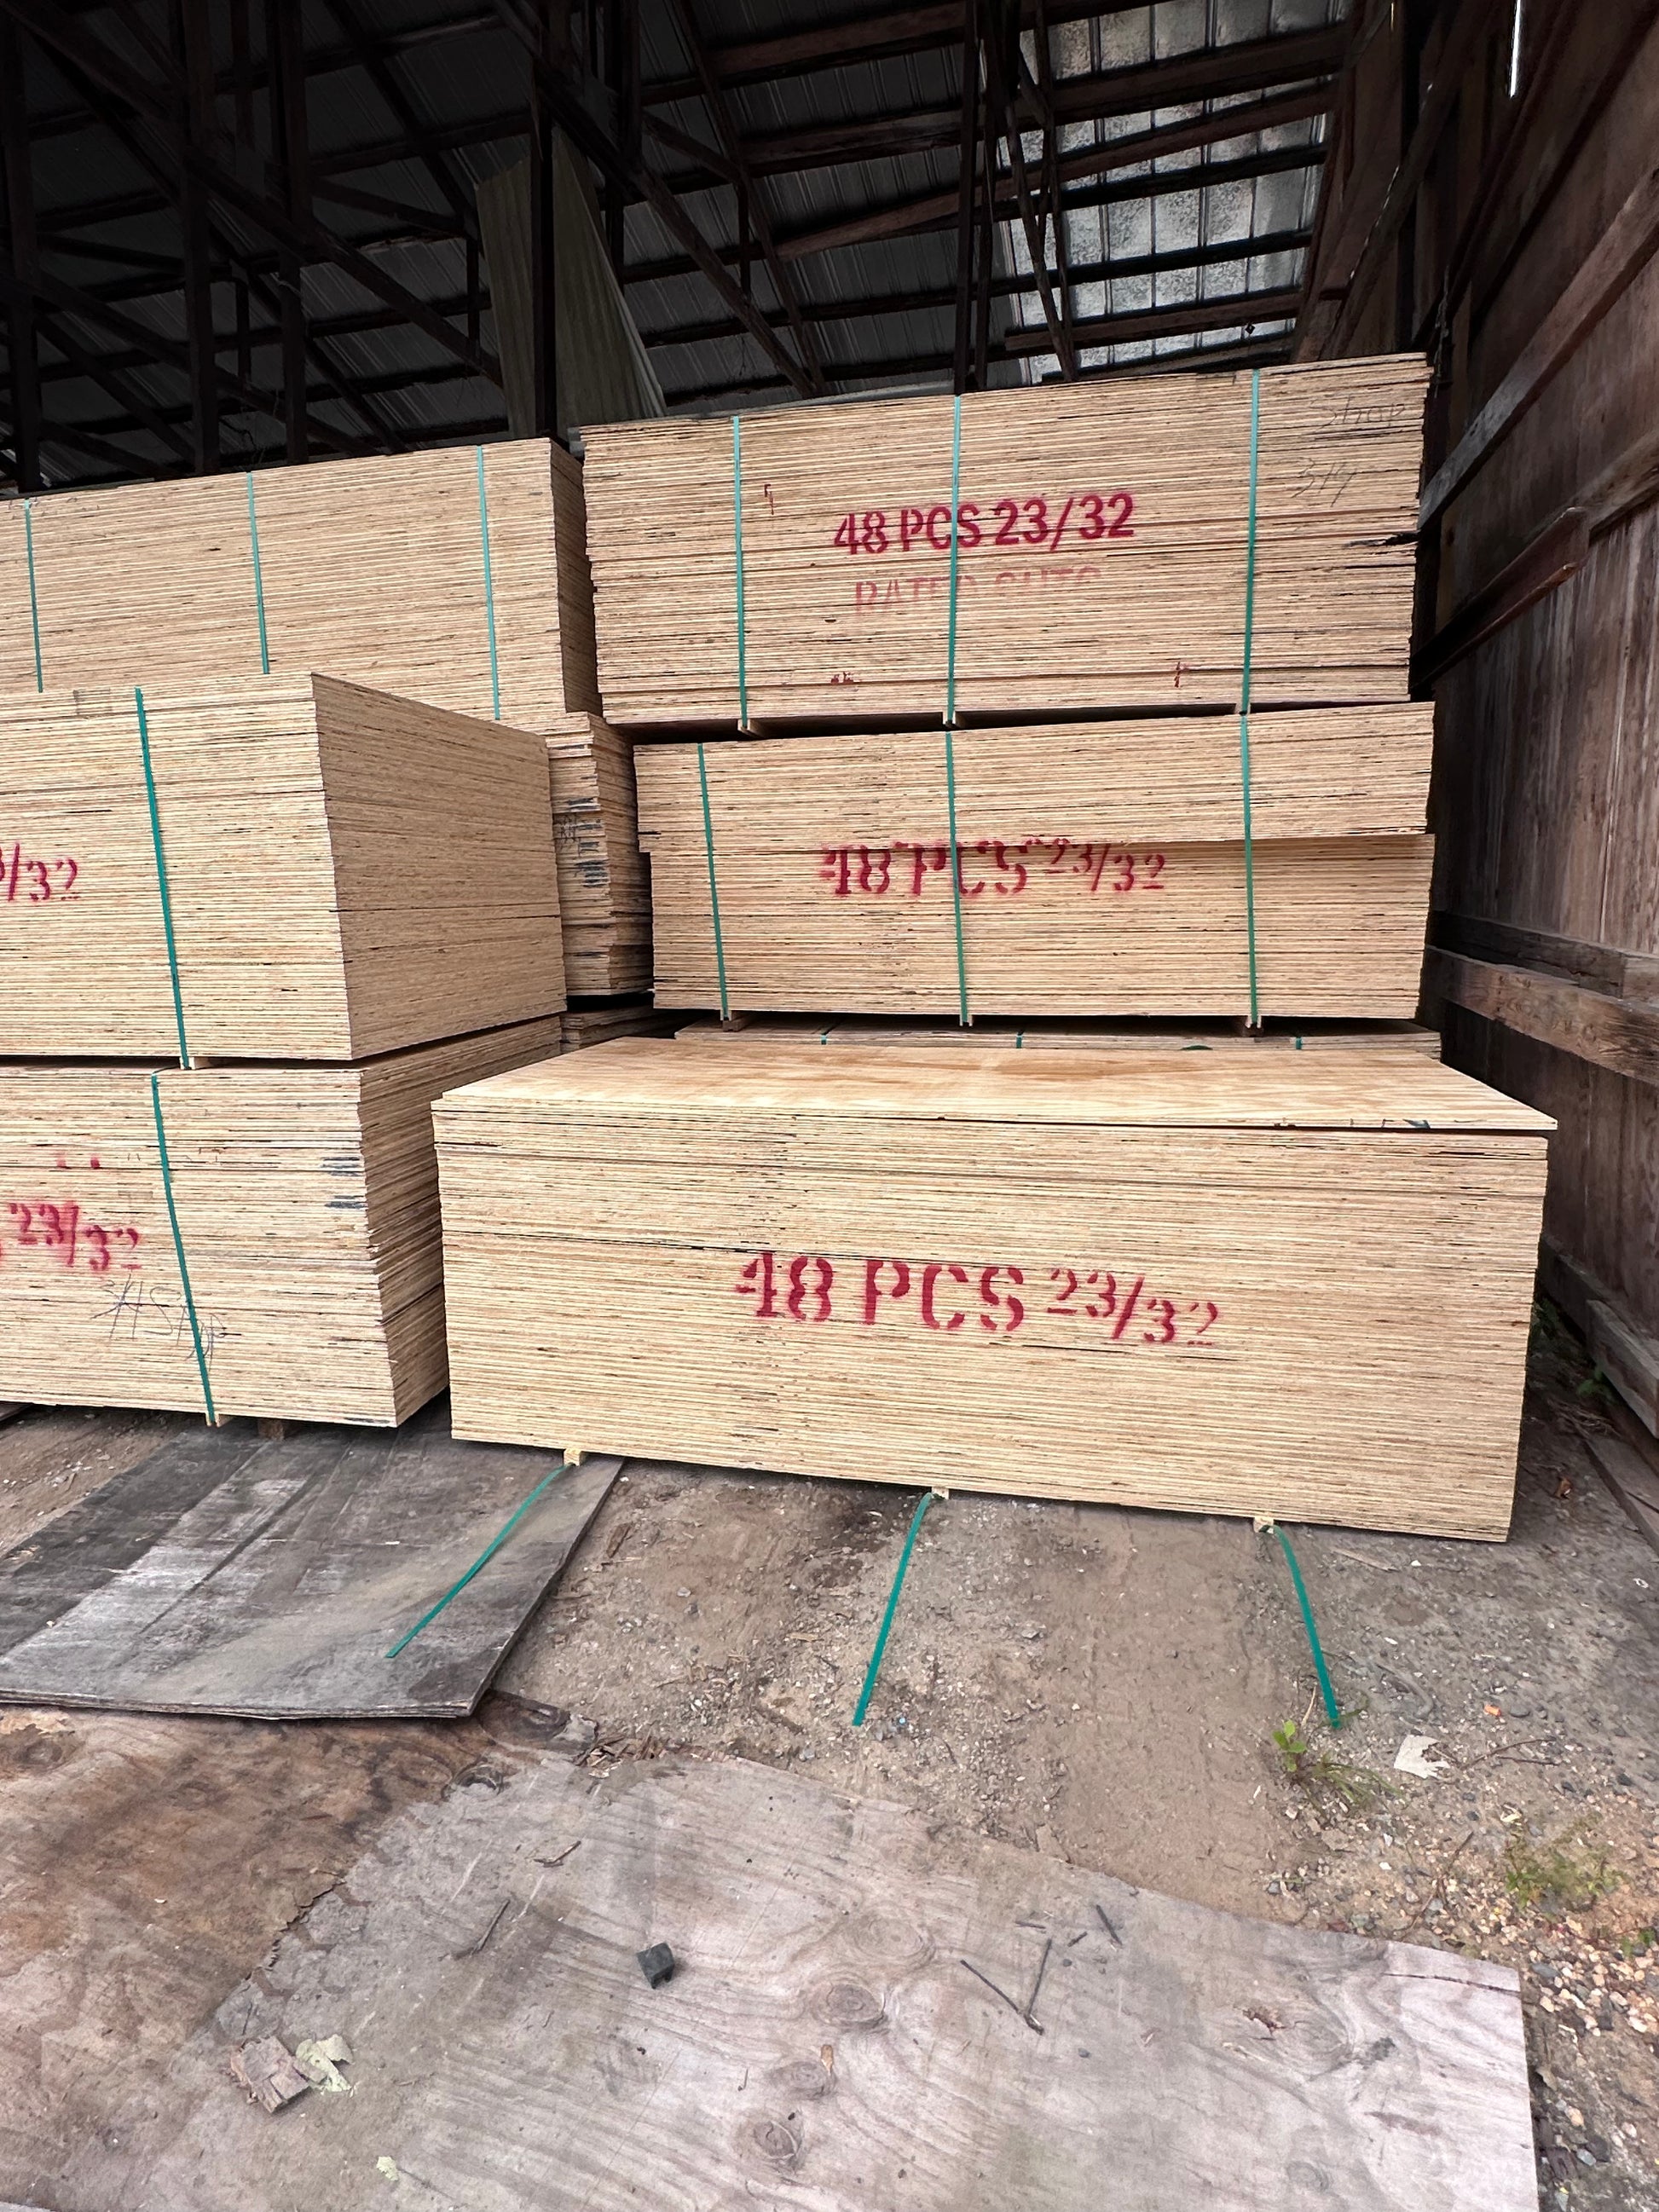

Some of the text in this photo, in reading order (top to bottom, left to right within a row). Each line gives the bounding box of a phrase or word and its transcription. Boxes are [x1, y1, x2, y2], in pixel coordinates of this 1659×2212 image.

[833, 492, 1136, 555] 48 PCS 23/32
[818, 844, 892, 896] 48
[893, 840, 1028, 896] PCS
[9, 1199, 143, 1273] 23/32
[736, 1250, 1219, 1347] 48 PCS 23/32
